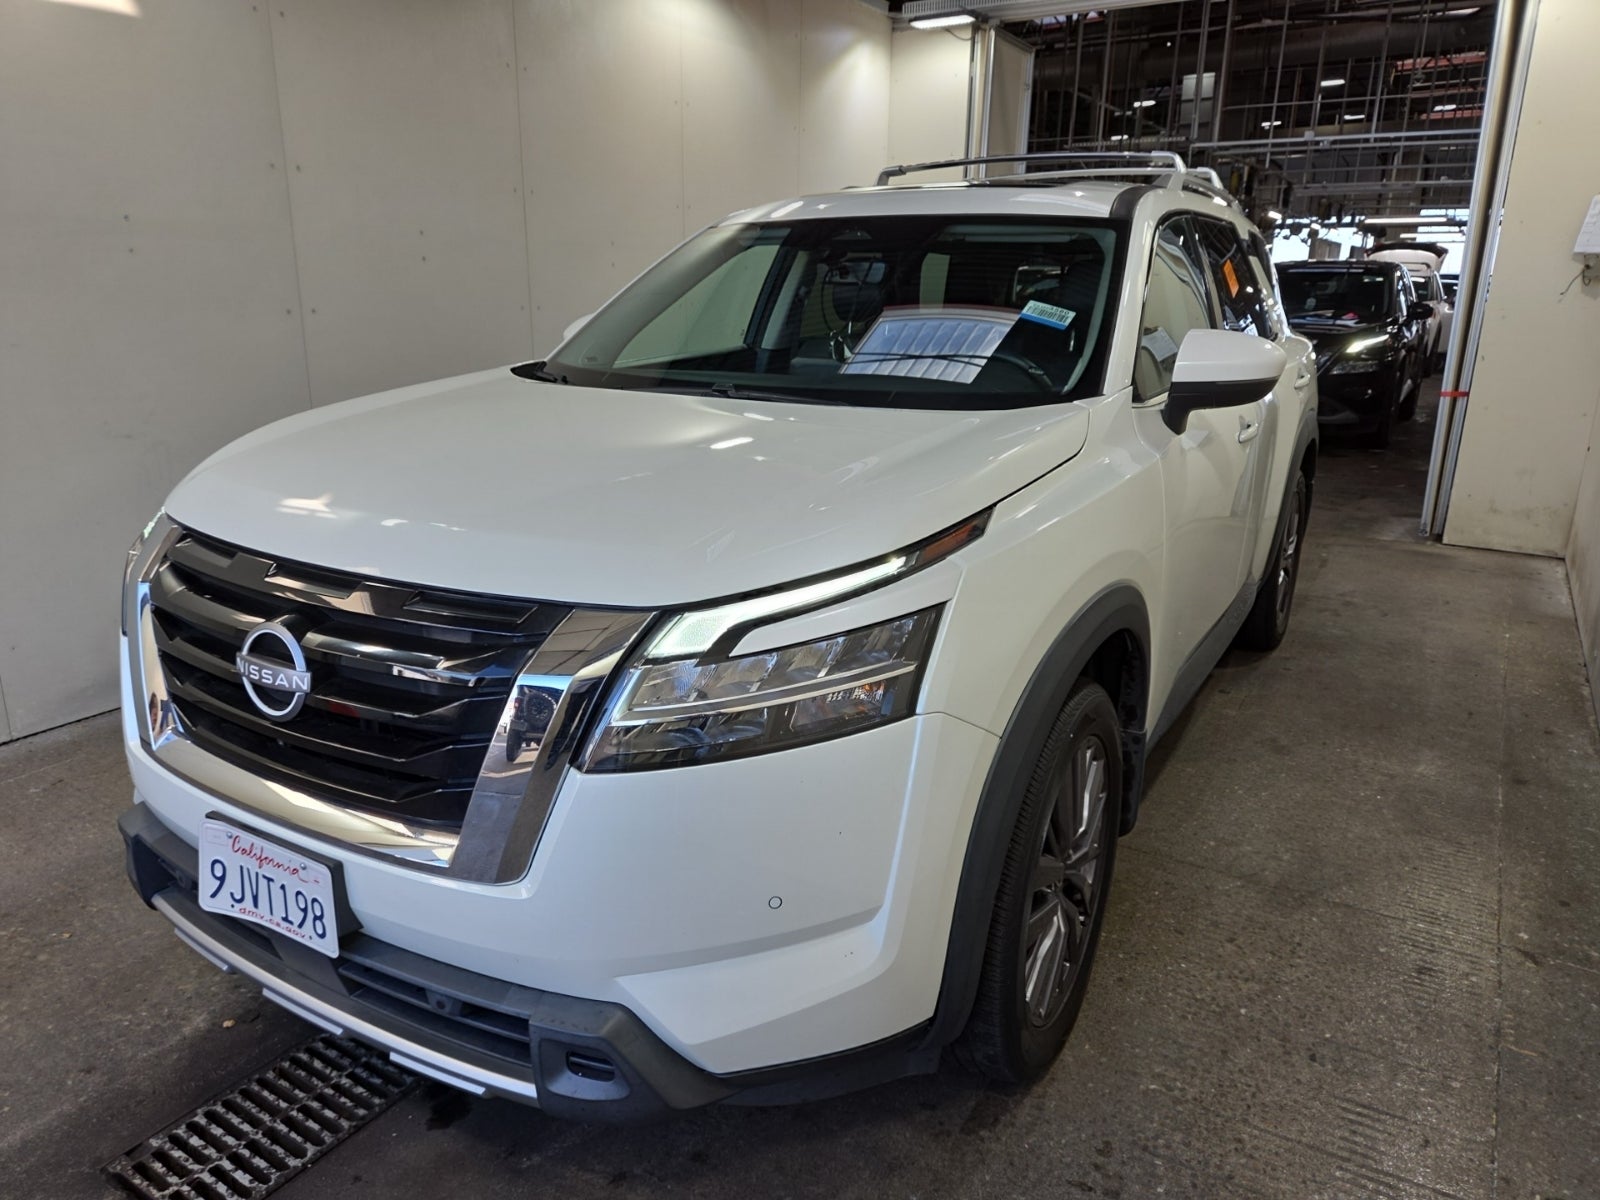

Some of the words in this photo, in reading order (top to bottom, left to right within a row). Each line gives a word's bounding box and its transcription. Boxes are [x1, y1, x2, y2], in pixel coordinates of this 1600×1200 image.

[237, 656, 308, 691] NISSAN
[231, 835, 308, 883] California
[210, 858, 326, 939] 9JVT198
[239, 907, 306, 938] dmv.ca.gov
